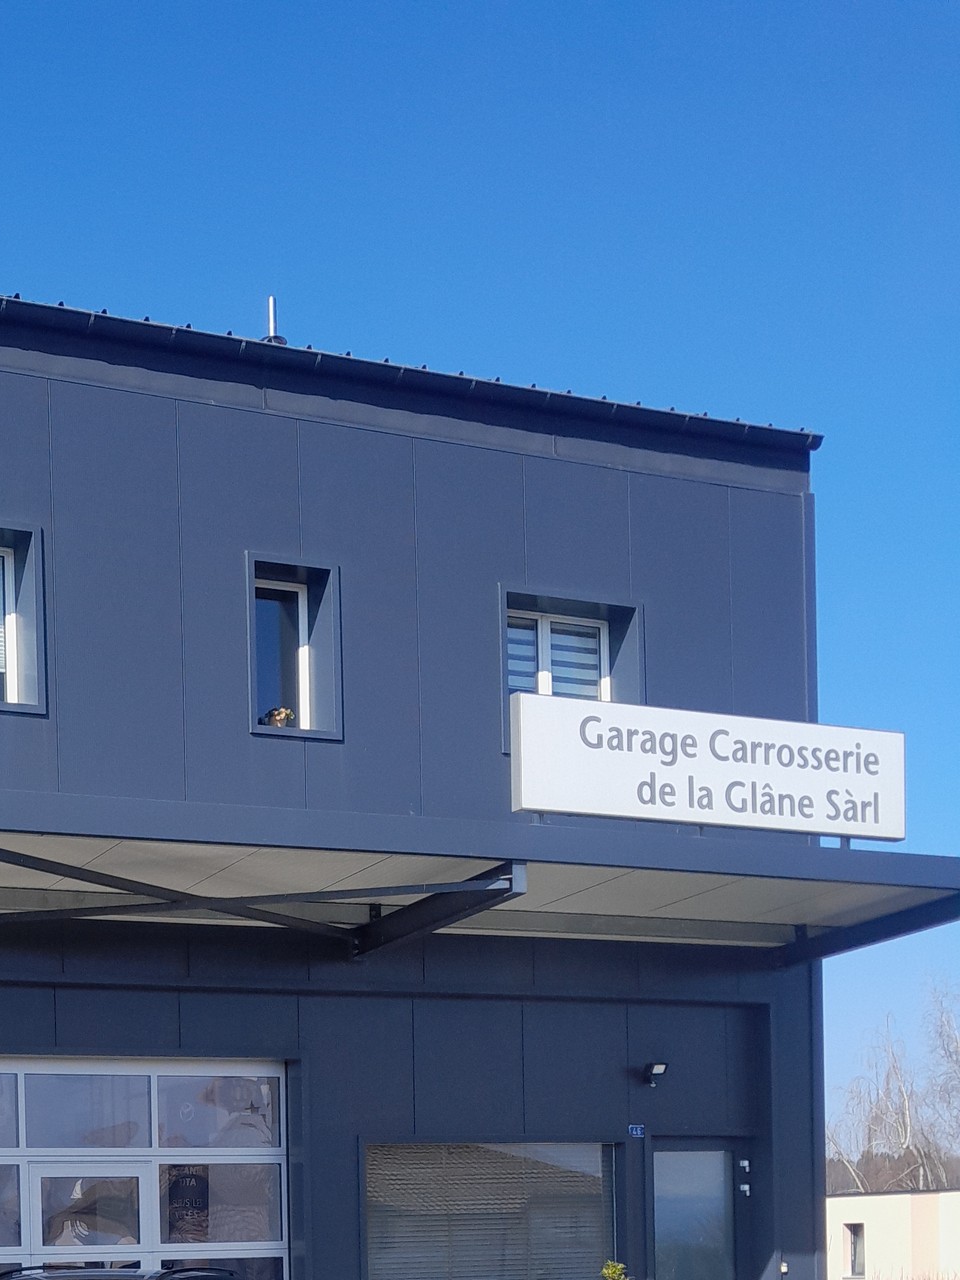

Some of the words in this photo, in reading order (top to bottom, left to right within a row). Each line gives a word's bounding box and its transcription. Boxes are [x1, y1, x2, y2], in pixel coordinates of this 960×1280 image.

[579, 715, 698, 766] Garage
[709, 729, 880, 776] Carrosserie
[637, 772, 677, 807] de
[688, 775, 714, 810] la
[725, 780, 815, 819] Glâne
[826, 788, 880, 825] Sàrl
